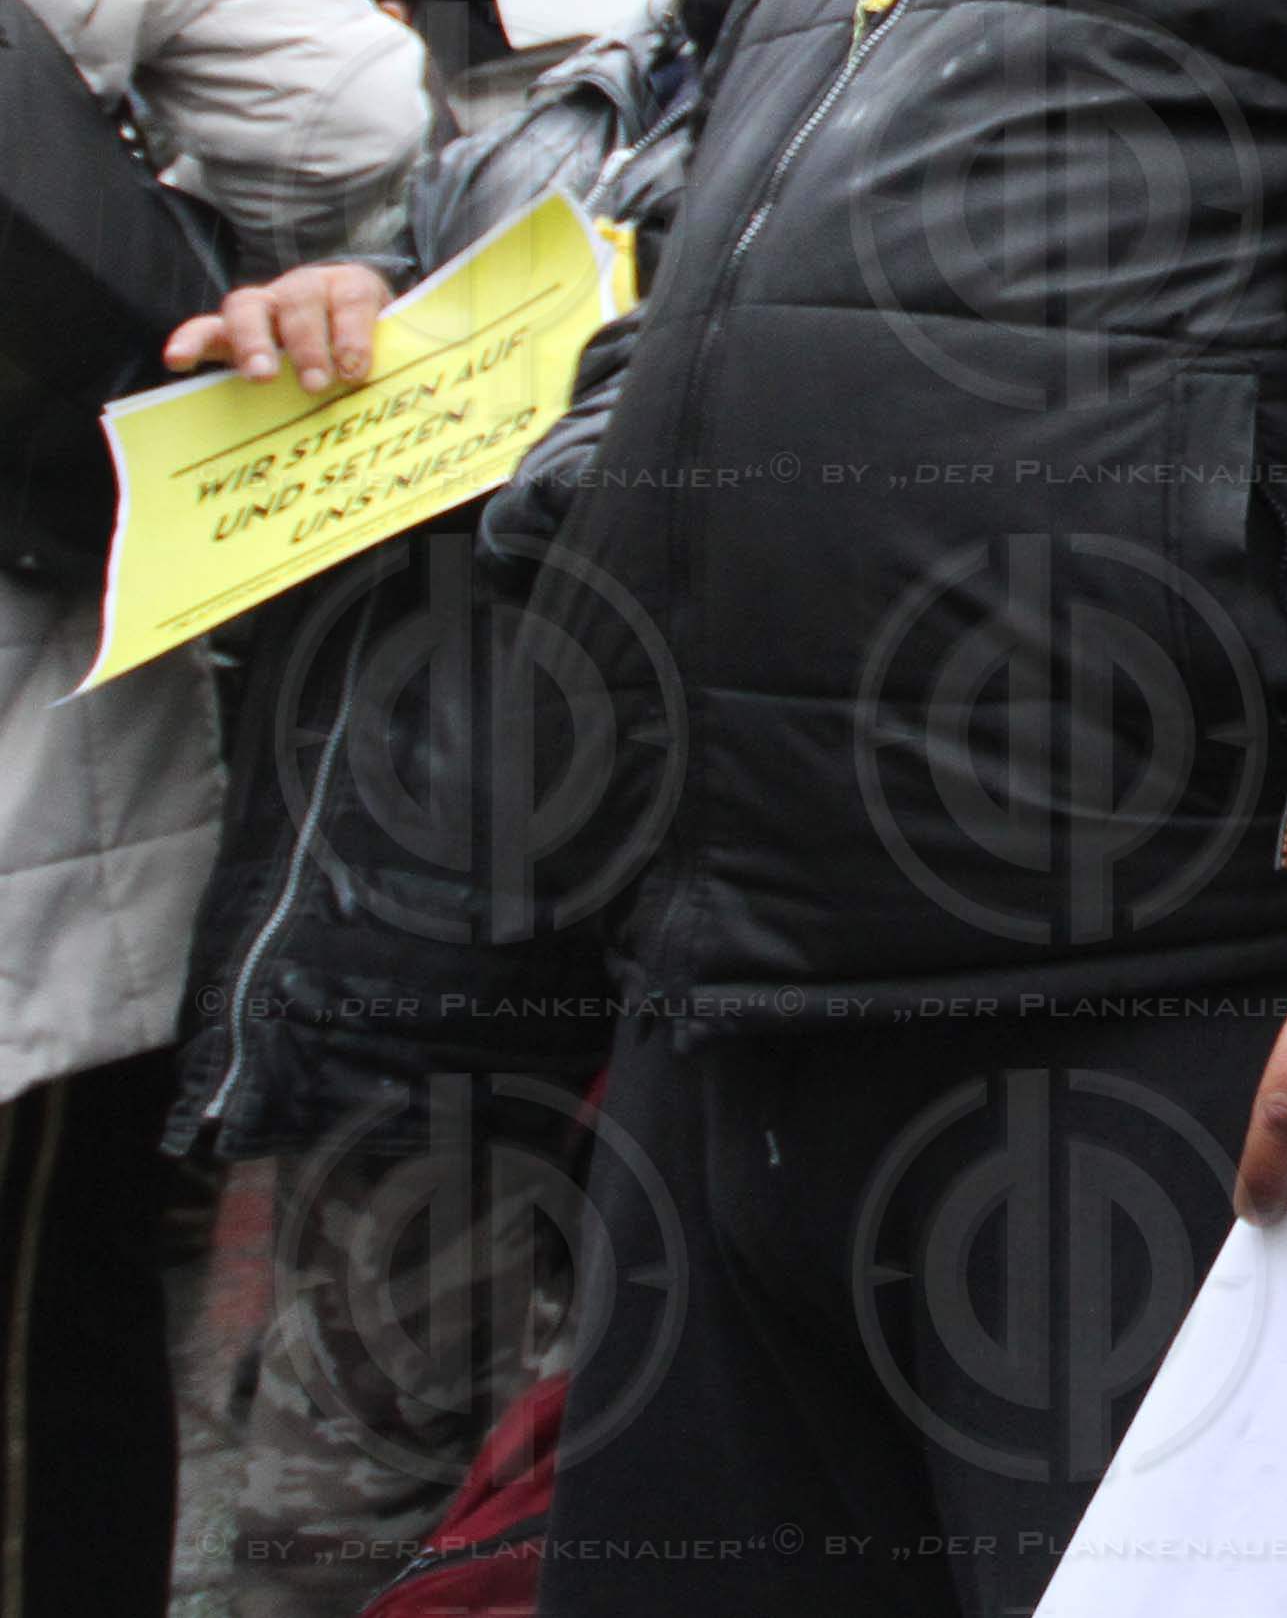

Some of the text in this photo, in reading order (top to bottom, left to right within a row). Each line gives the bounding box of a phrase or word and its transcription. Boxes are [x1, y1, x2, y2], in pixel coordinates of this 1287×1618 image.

[195, 454, 276, 505] WIR
[285, 373, 445, 468] STEHEN
[452, 326, 529, 387] AUF
[213, 482, 304, 543] UND
[312, 399, 473, 497] SETZEN
[290, 406, 538, 546] UNS NIEDER
